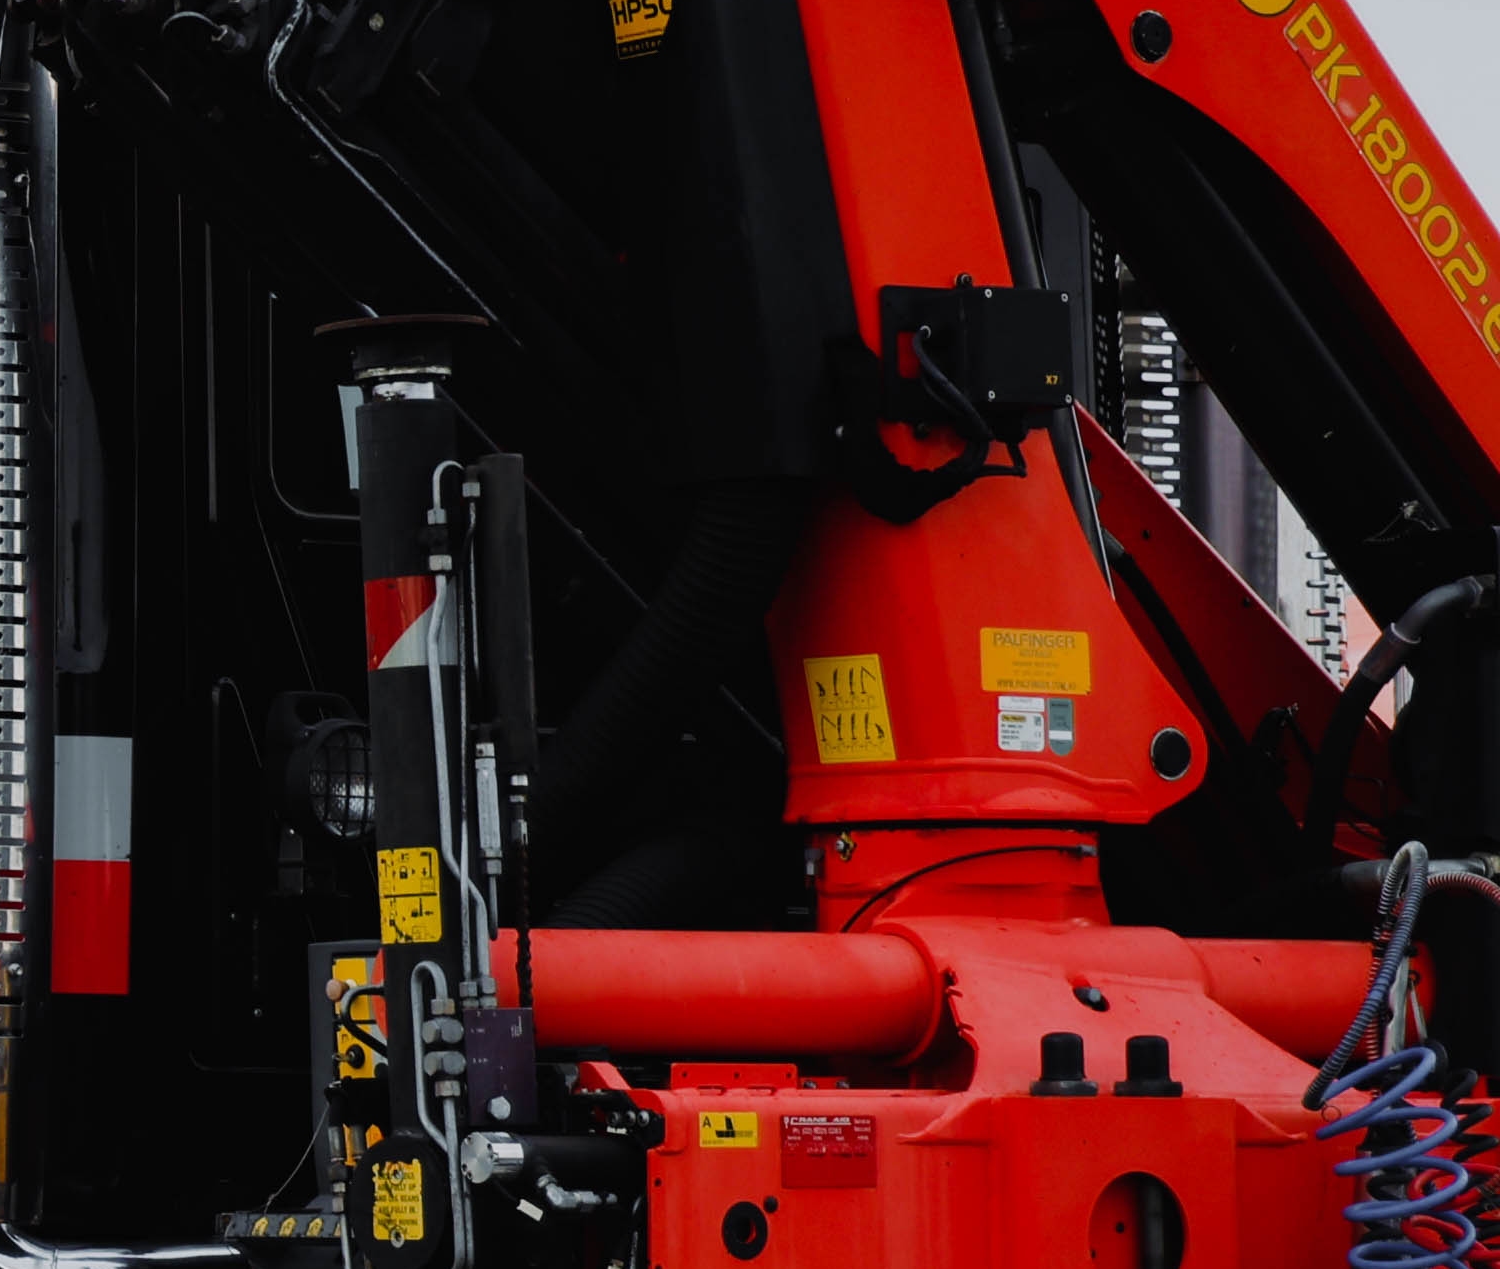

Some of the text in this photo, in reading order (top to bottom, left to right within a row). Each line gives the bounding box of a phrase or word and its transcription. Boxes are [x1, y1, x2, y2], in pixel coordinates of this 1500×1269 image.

[1285, 2, 1364, 106] PK
[1045, 374, 1059, 385] X7
[992, 632, 1077, 649] PALFINGER
[702, 1115, 712, 1128] A
